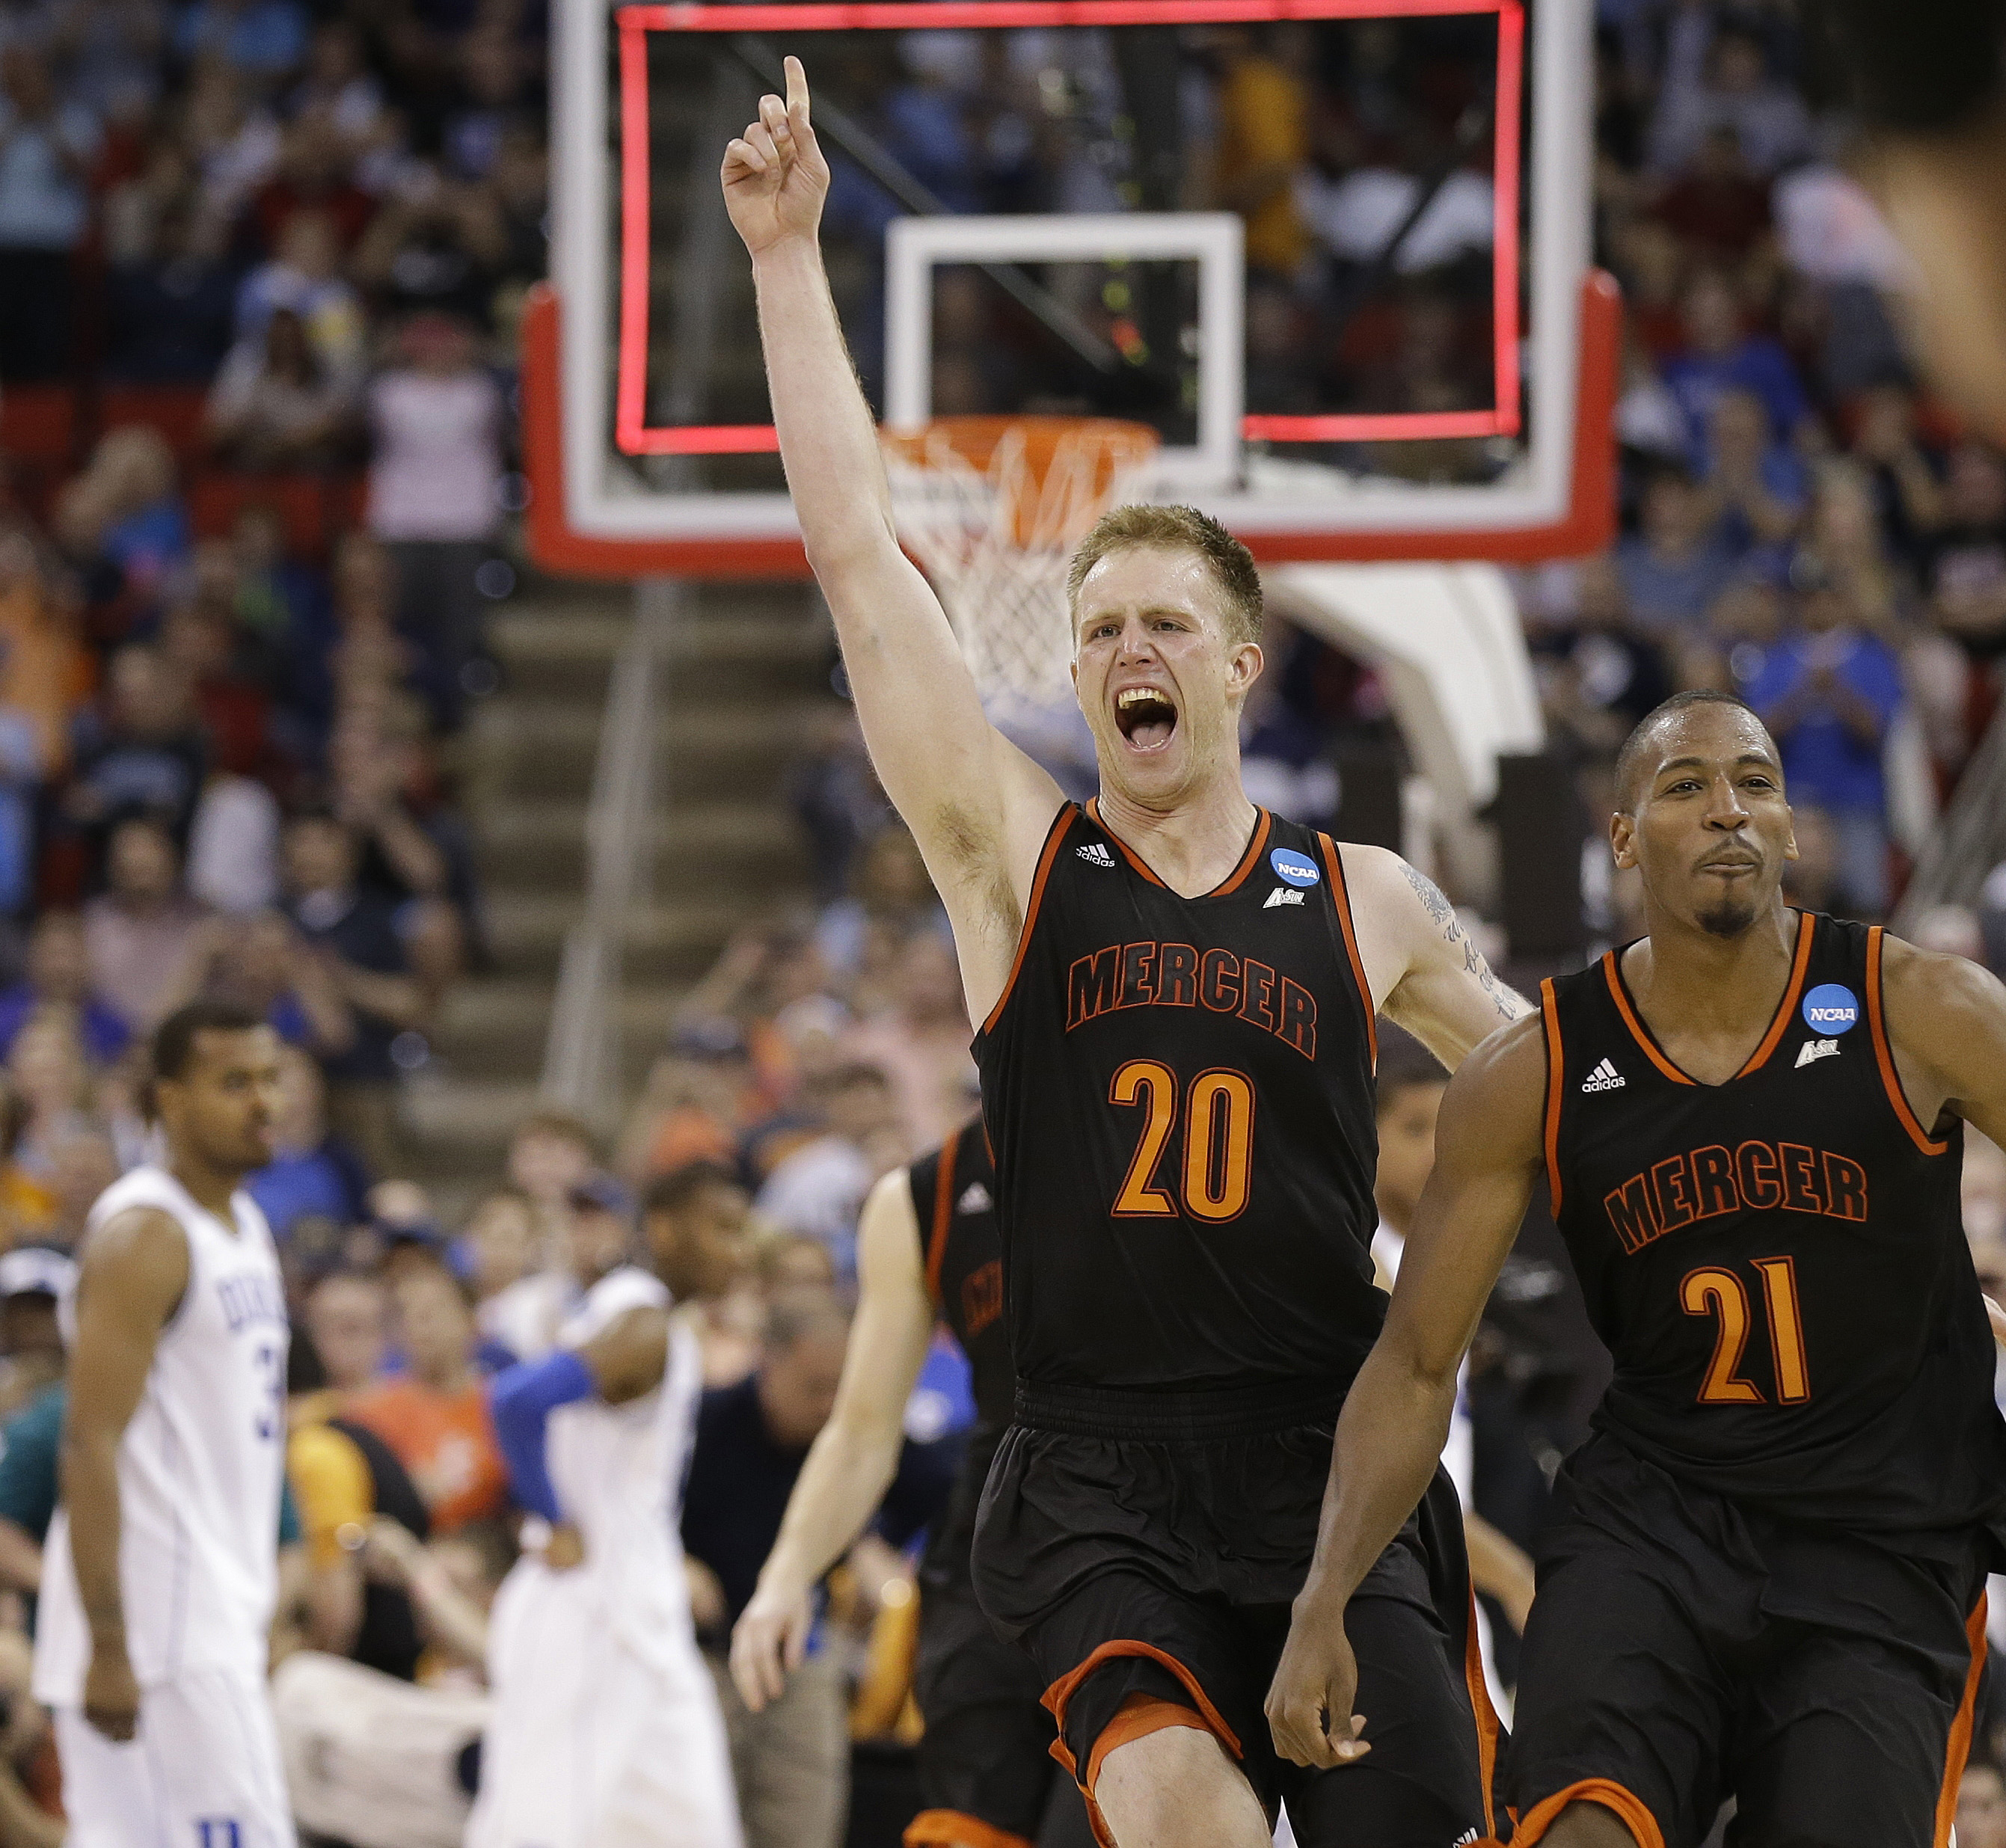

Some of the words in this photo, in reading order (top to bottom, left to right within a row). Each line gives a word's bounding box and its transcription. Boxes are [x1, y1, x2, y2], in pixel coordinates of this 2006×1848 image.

[1277, 862, 1318, 880] NCAA
[1065, 941, 1317, 1062] MERCER
[1810, 1007, 1856, 1022] NCAA
[1108, 1058, 1257, 1224] 20
[1581, 1076, 1625, 1093] adidas
[1604, 1140, 1868, 1255] MERCER
[1678, 1254, 1811, 1405] 21
